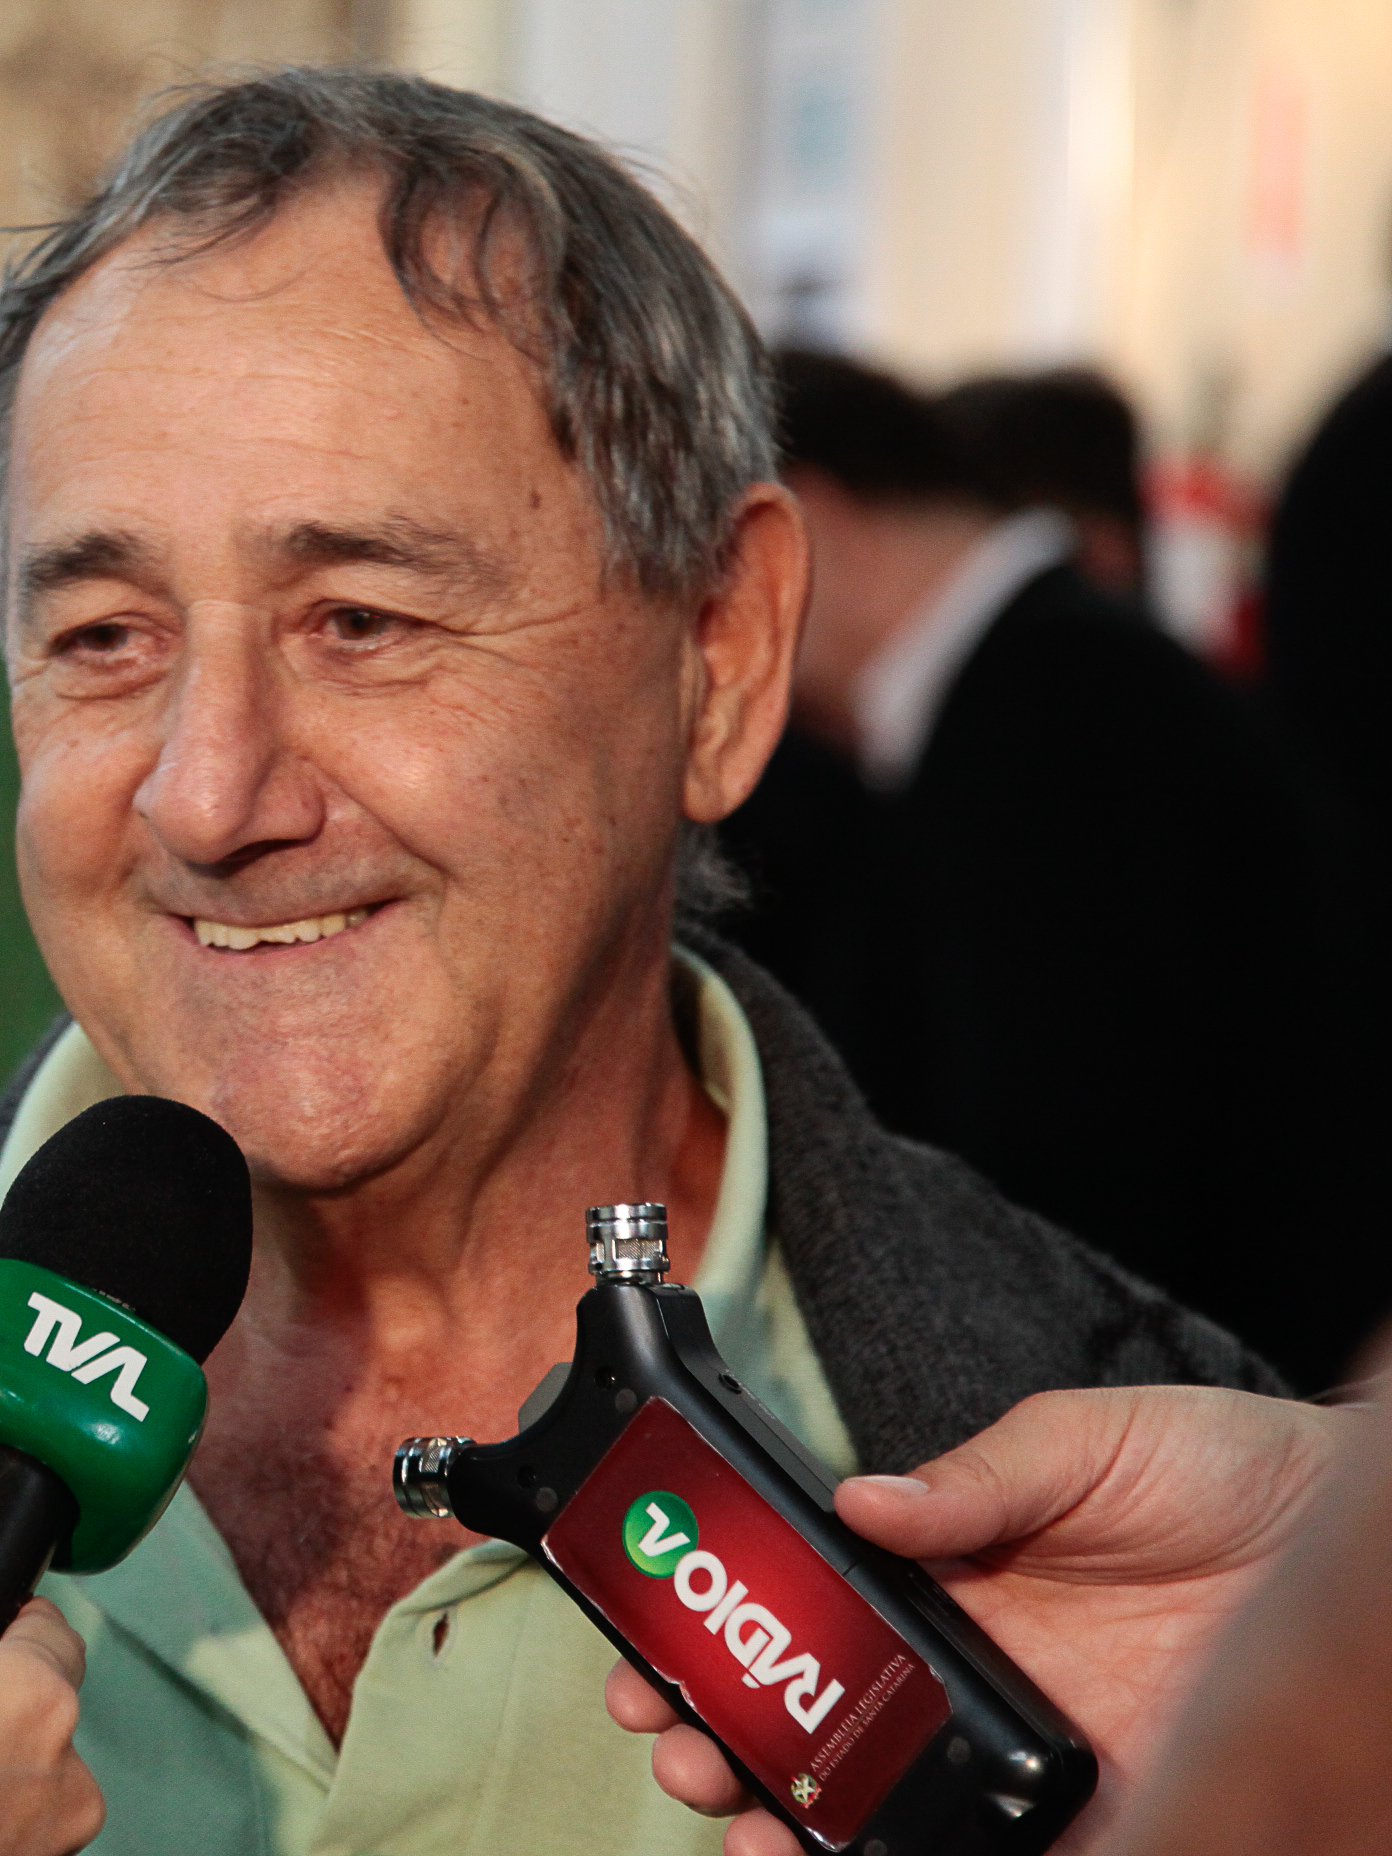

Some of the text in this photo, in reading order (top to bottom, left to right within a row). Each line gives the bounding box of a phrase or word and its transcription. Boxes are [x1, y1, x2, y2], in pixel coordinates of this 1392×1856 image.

[818, 1663, 916, 1781] DO ESTADO DE SANTA CATARINA
[855, 1654, 906, 1715] LEGISLATIVA
